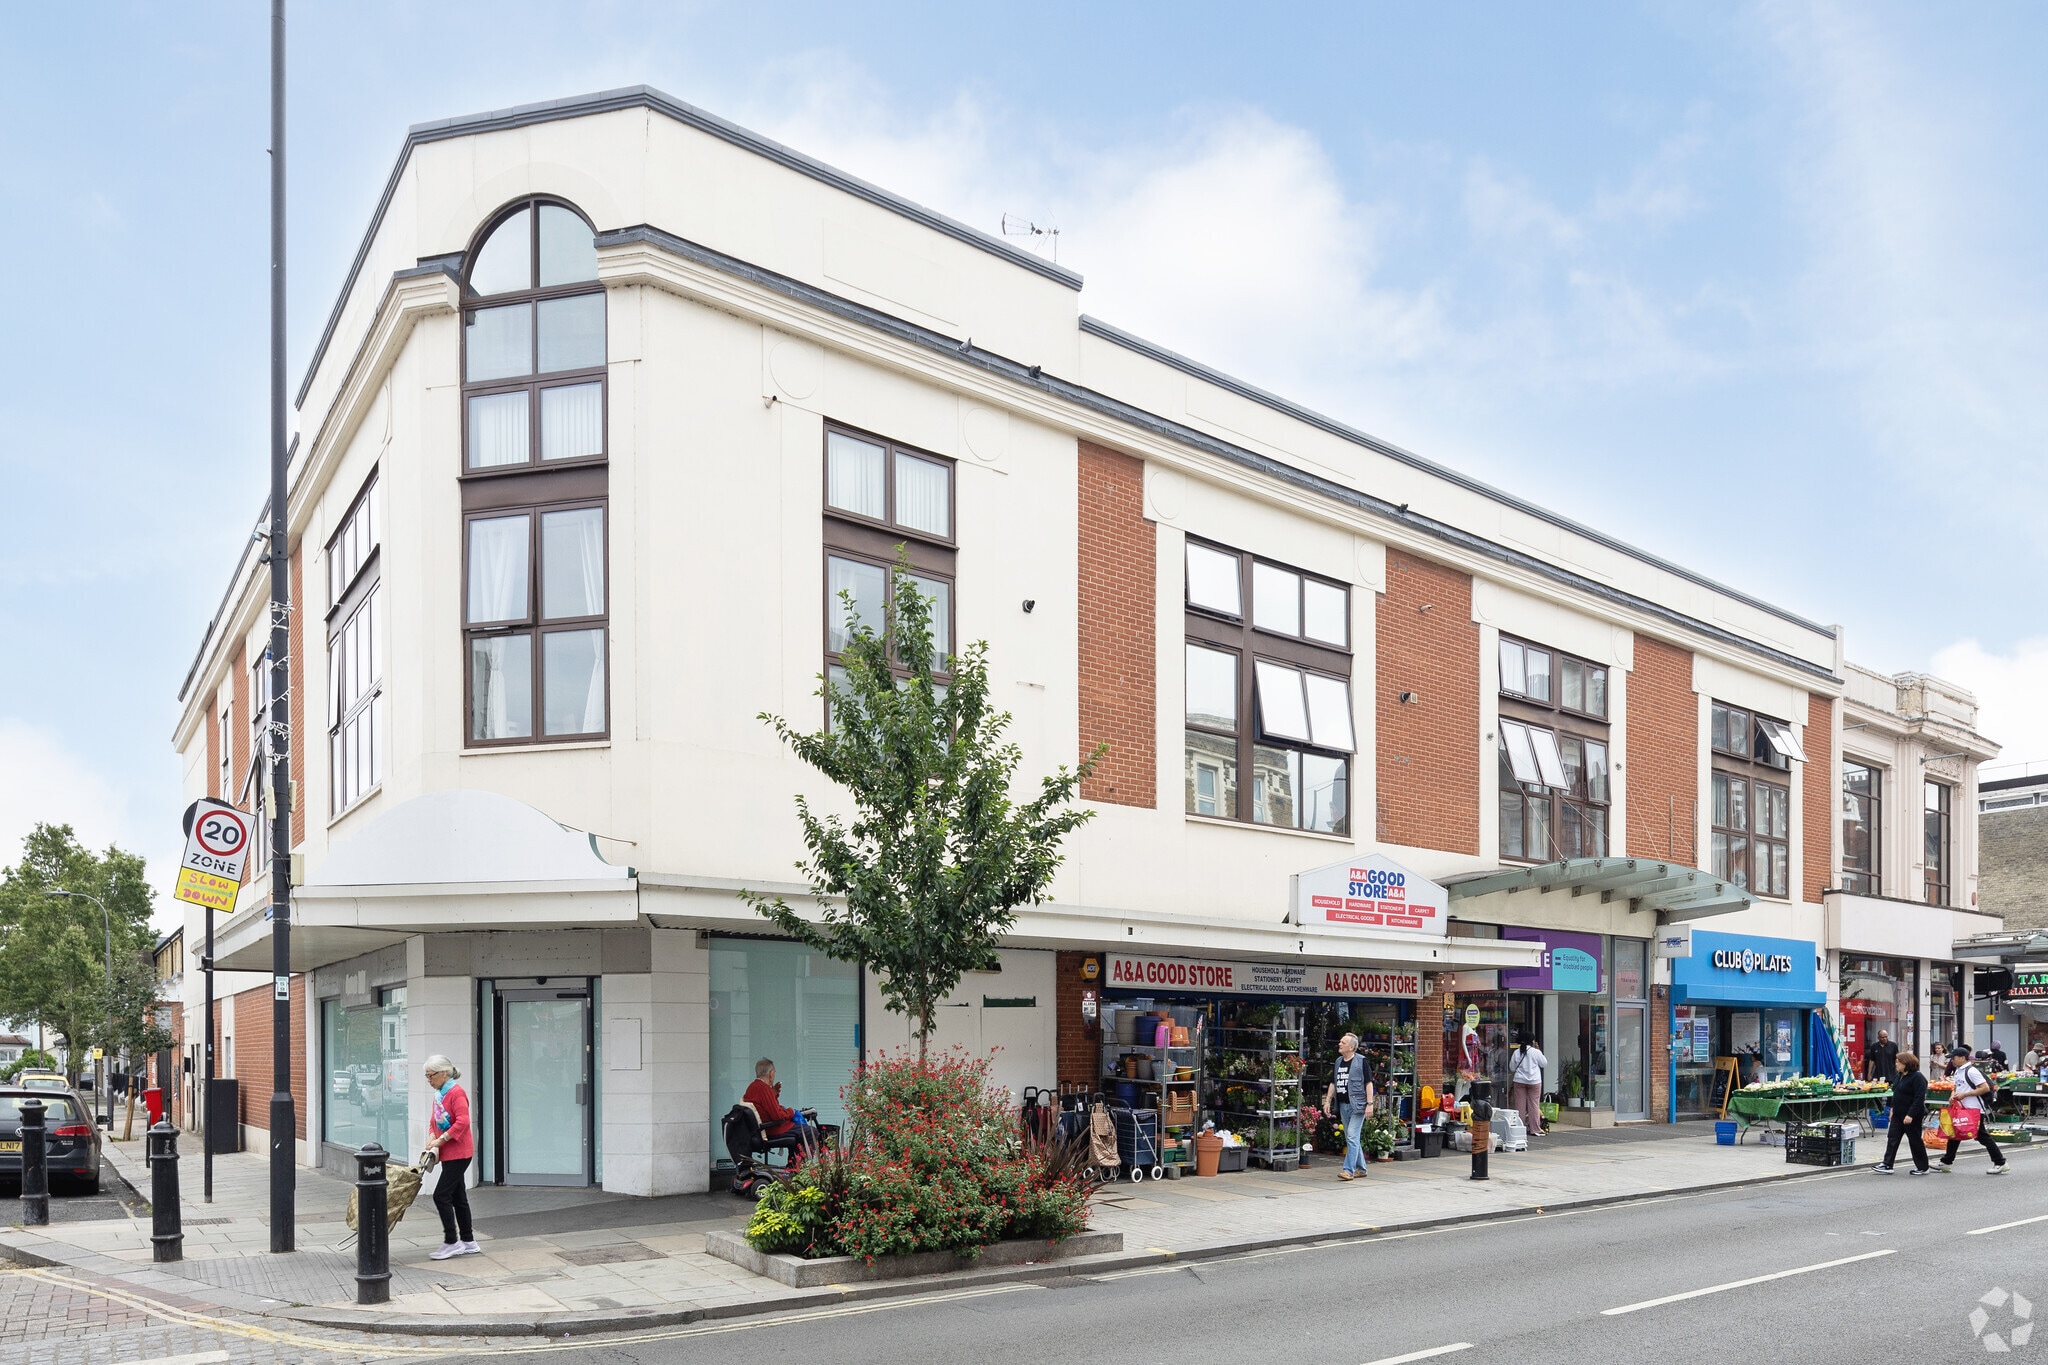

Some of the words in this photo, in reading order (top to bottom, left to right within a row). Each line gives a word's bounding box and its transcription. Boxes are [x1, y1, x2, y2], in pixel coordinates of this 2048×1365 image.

[204, 820, 240, 845] 20
[190, 852, 237, 874] ZONE
[189, 872, 229, 890] SLOW
[1350, 869, 1367, 881] A&A
[1367, 869, 1405, 887] GOOD
[183, 888, 228, 906] DOWN
[1348, 881, 1388, 899] STORE
[1388, 887, 1405, 899] A&A
[1563, 954, 1580, 963] Equality
[1714, 949, 1742, 969] CLUB
[1754, 953, 1792, 973] PILATES
[1113, 960, 1145, 982] A&A
[1146, 962, 1186, 985] GOOD
[1188, 964, 1233, 987] STORE
[1251, 966, 1279, 974] HOUSEHOLD
[1254, 975, 1282, 983] STATIONERY
[1325, 972, 1350, 991] A&A
[1351, 973, 1383, 992] GOOD
[1384, 975, 1418, 994] STORE
[2008, 986, 2046, 996] HALAL
